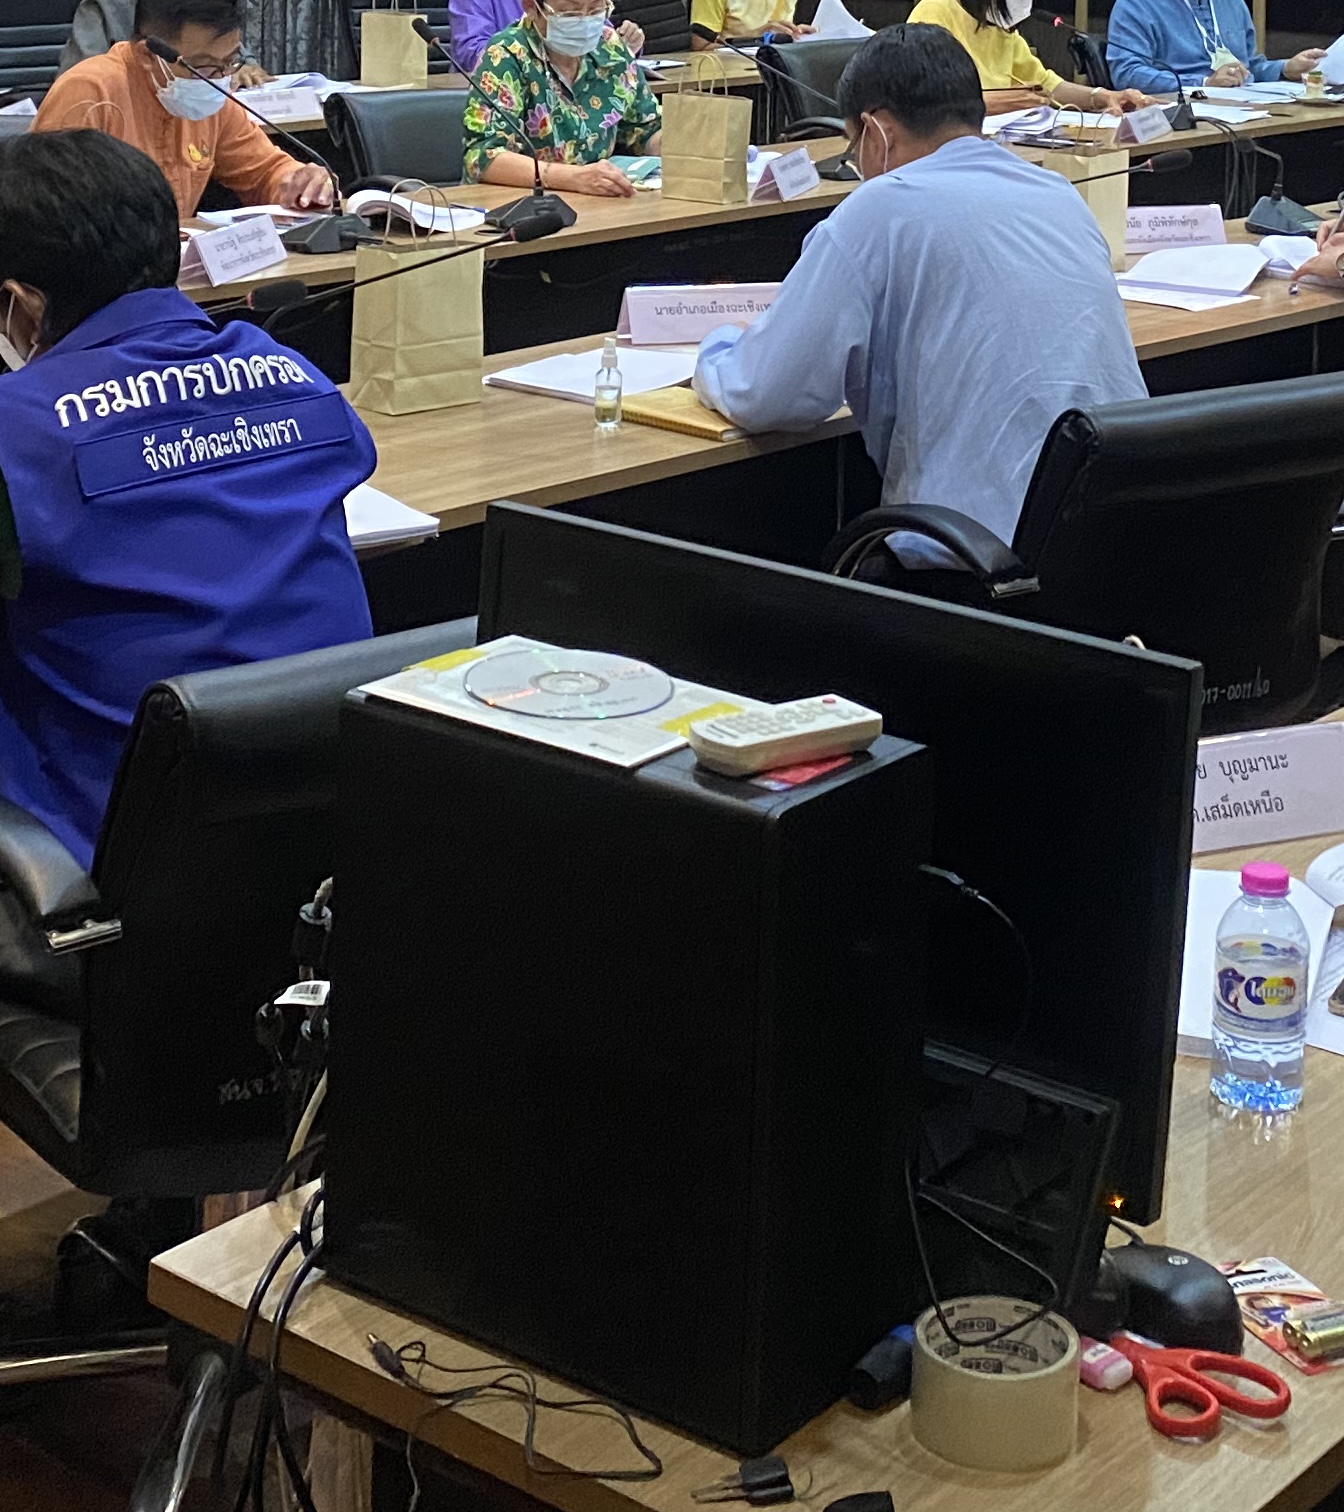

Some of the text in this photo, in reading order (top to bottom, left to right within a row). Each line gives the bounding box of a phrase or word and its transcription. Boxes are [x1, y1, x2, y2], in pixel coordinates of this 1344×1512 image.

[654, 299, 772, 317] นายอำเภอเมืองฉะเชิงเท
[142, 416, 303, 472] จังหวัดฉะเชิงเทรา
[1218, 752, 1290, 784] บุญมานะ
[1229, 1268, 1297, 1289] nasonic
